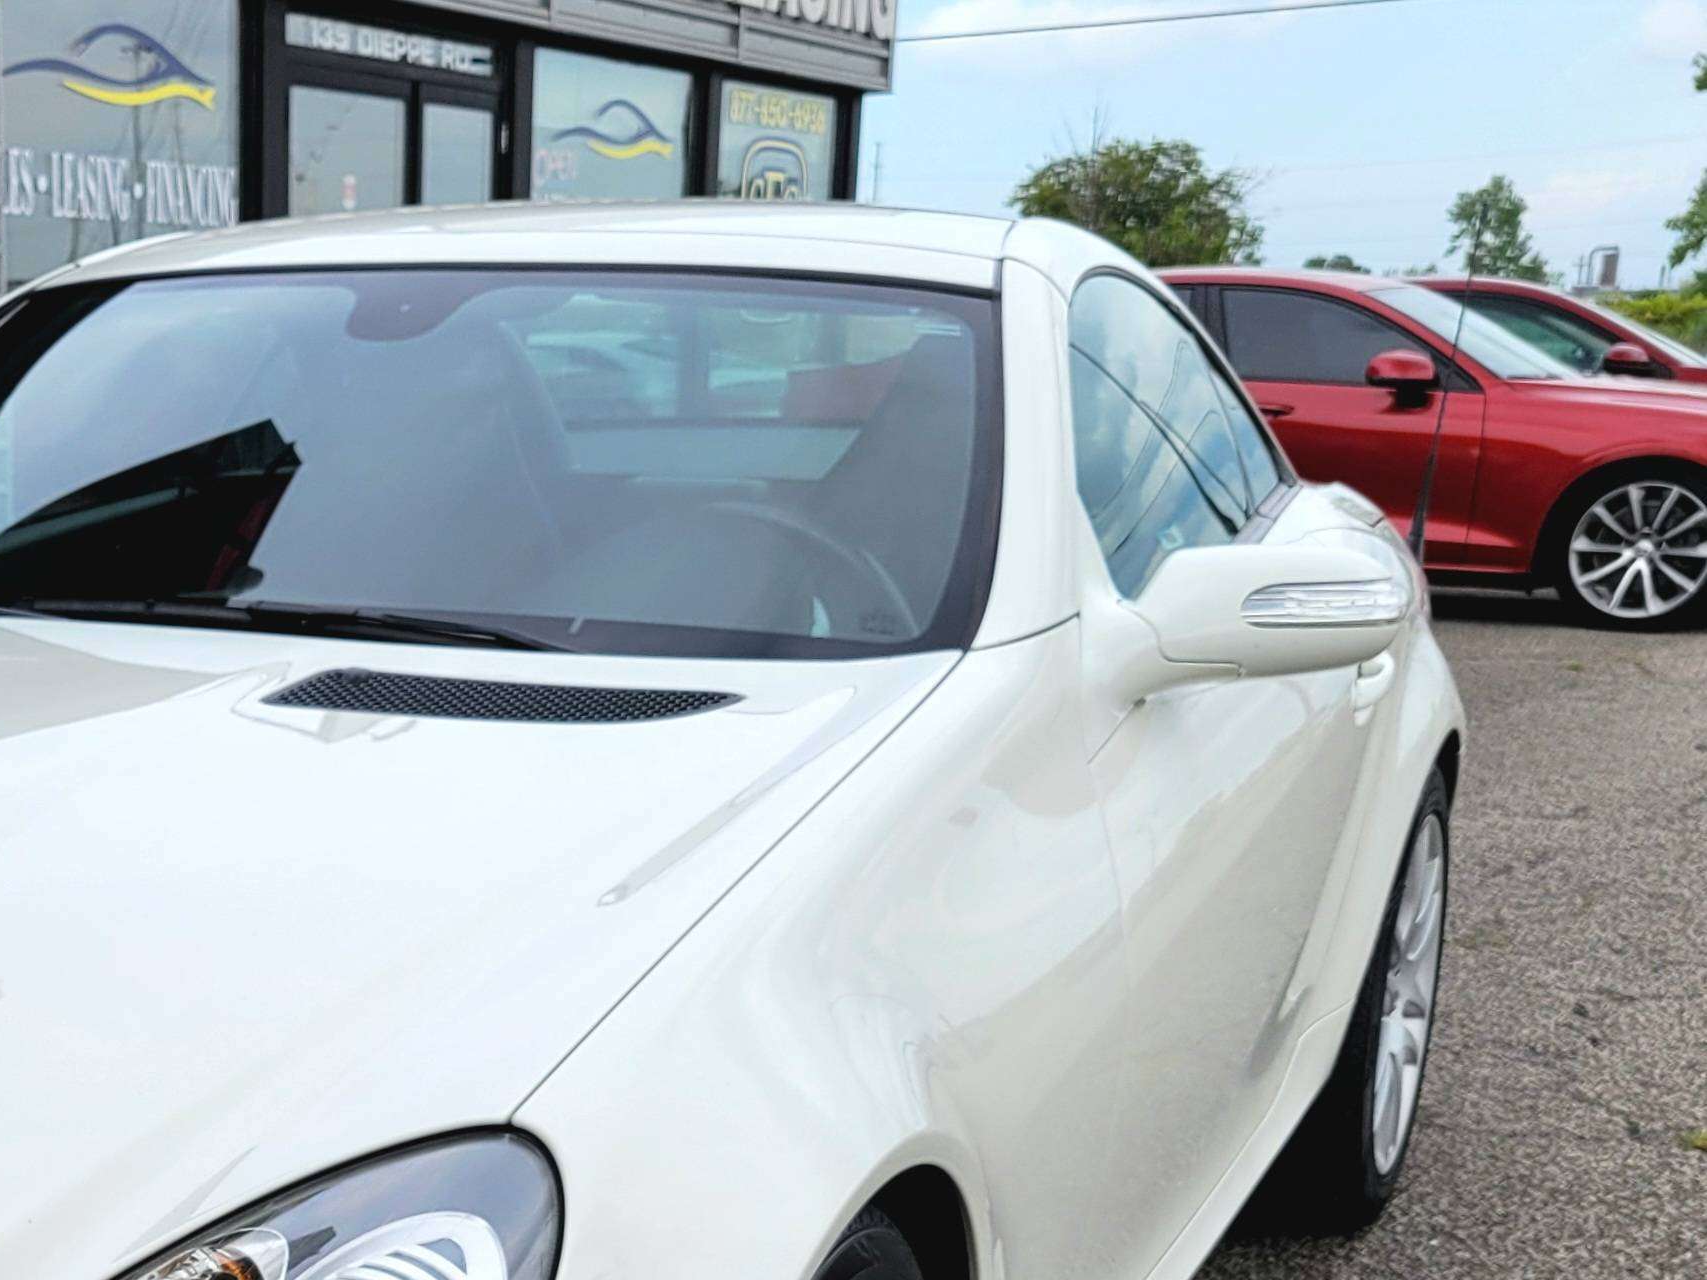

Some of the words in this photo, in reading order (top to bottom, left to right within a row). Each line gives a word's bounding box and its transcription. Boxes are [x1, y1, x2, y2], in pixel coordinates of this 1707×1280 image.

[357, 27, 438, 68] DIEPPE
[50, 151, 131, 222] LEASING
[146, 159, 239, 229] FINANCING
